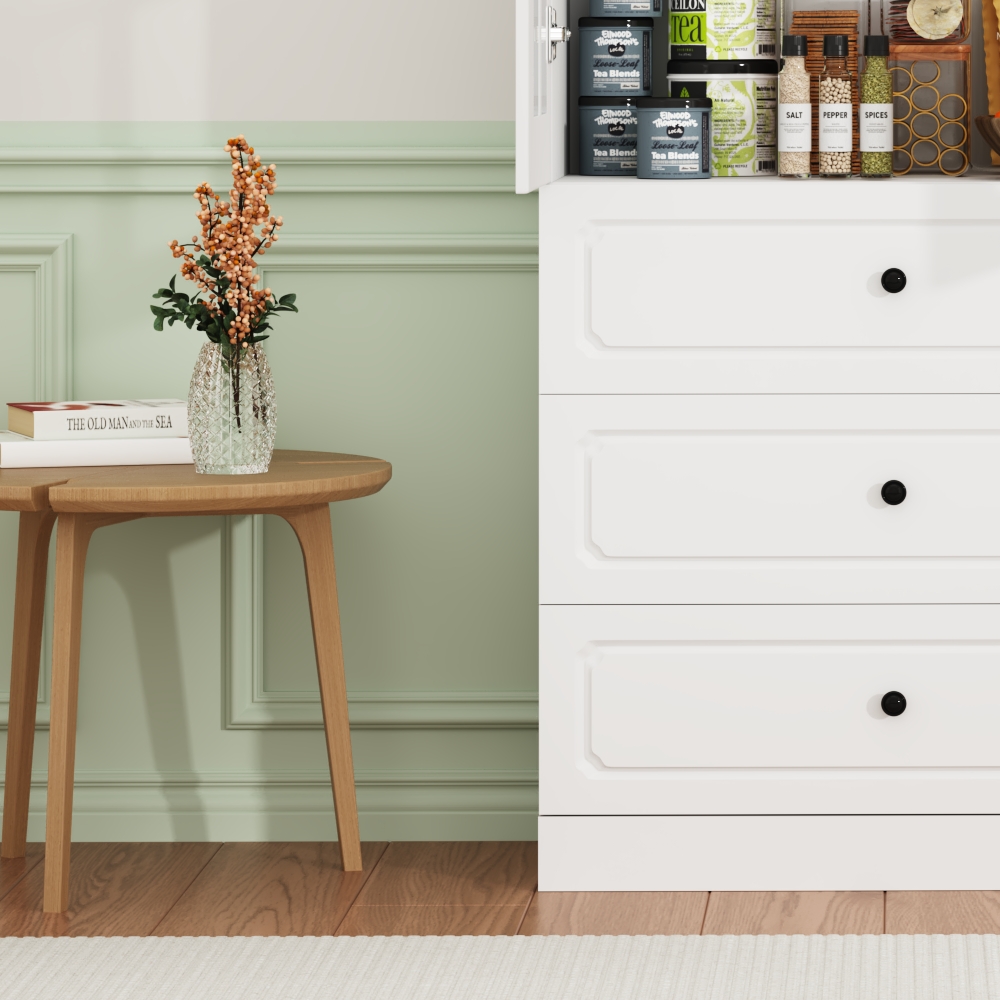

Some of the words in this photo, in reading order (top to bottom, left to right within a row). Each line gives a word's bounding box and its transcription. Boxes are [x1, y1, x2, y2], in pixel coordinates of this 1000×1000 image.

[593, 59, 640, 70] Loose-Leaf
[593, 70, 608, 78] Tea
[609, 70, 640, 78] Blends
[651, 141, 699, 151] Loose-Leaf
[593, 148, 608, 156] Tea
[651, 152, 666, 160] Tea
[668, 152, 699, 160] Blends
[67, 418, 86, 431] THE
[87, 417, 106, 430] OLD
[108, 416, 129, 430] MAN
[129, 420, 141, 429] AND
[142, 419, 154, 429] THE
[155, 415, 173, 429] SEA
